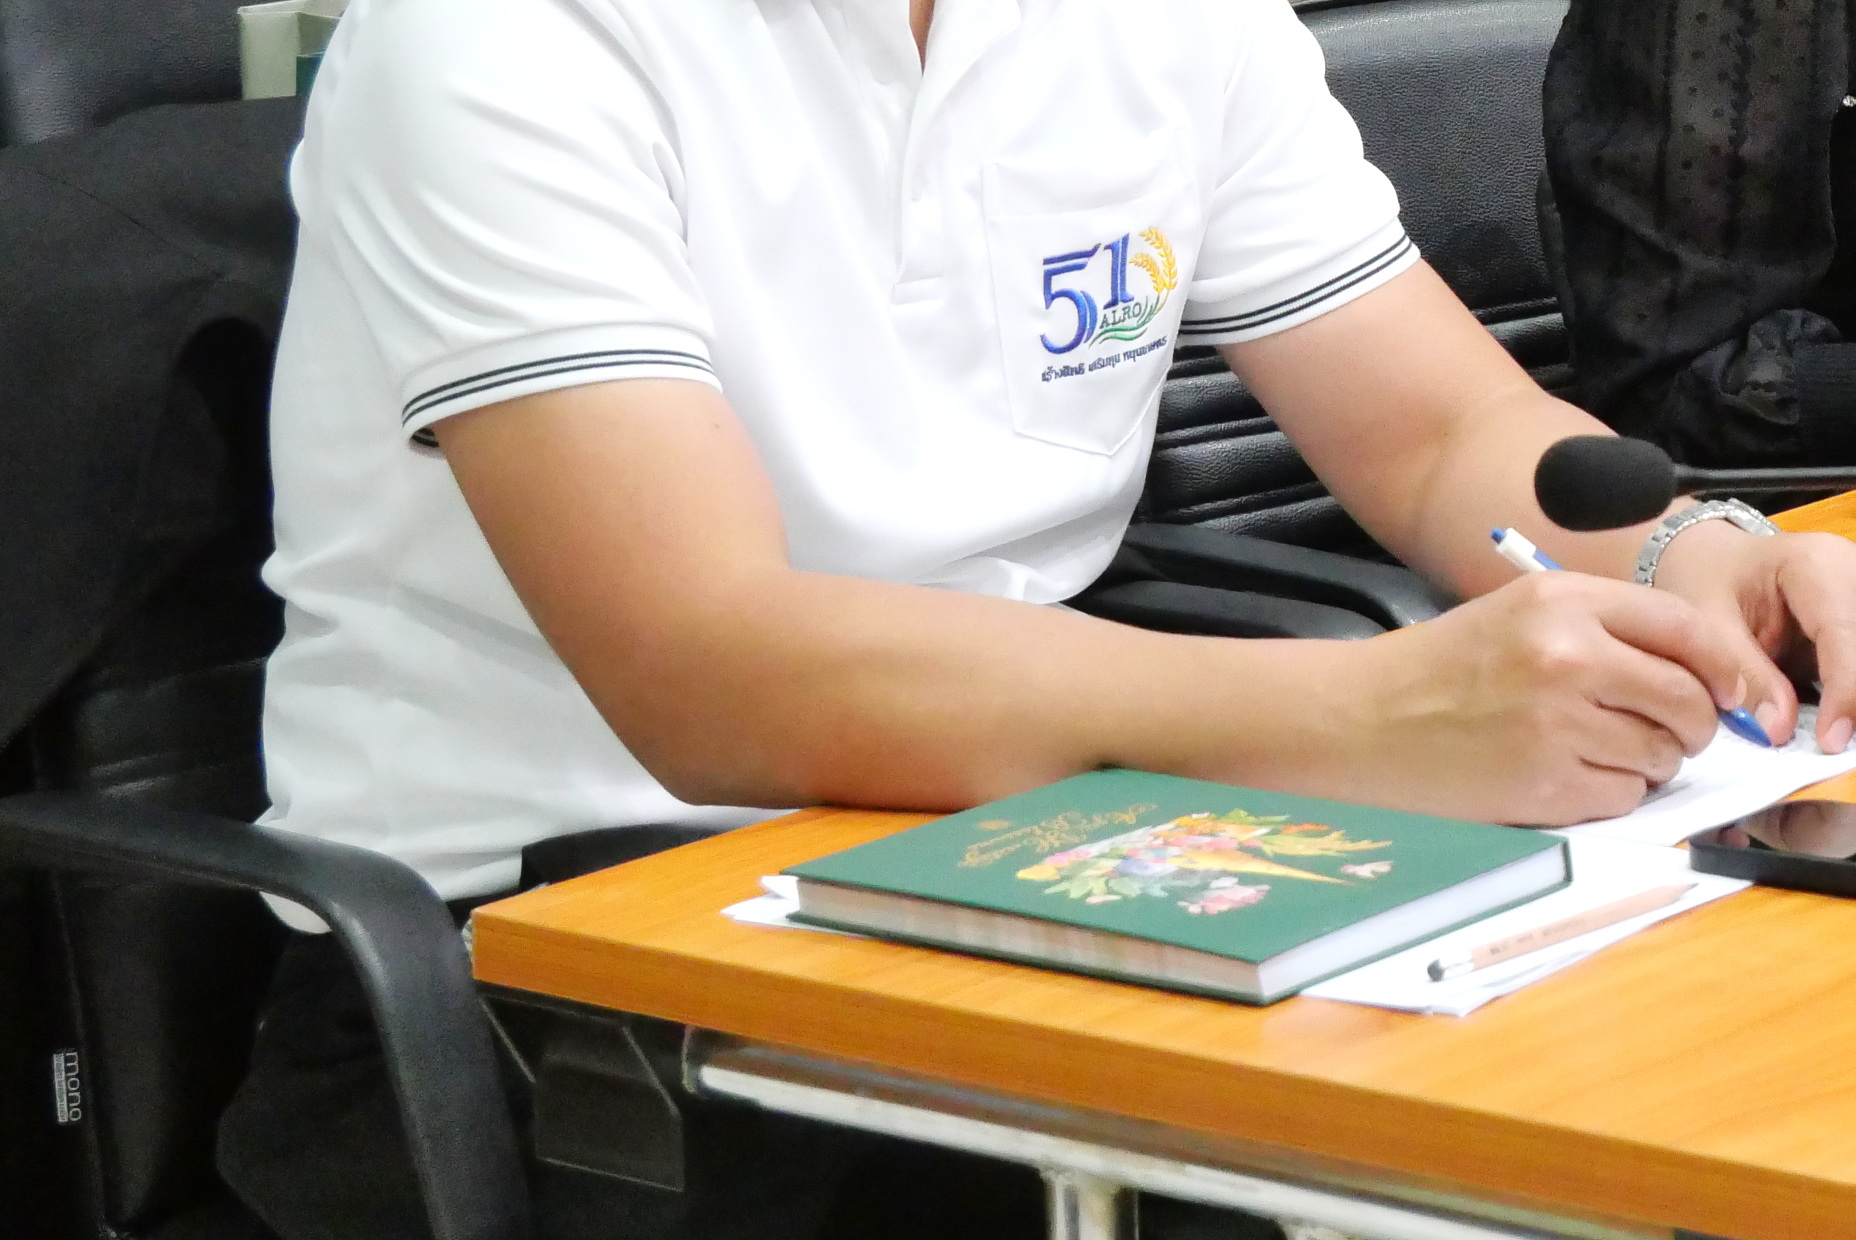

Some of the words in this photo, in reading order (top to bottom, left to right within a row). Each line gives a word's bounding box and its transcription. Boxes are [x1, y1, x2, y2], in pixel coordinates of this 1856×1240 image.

[1040, 232, 1135, 355] 51
[1099, 301, 1143, 330] ALRO
[65, 1051, 82, 1122] mono
